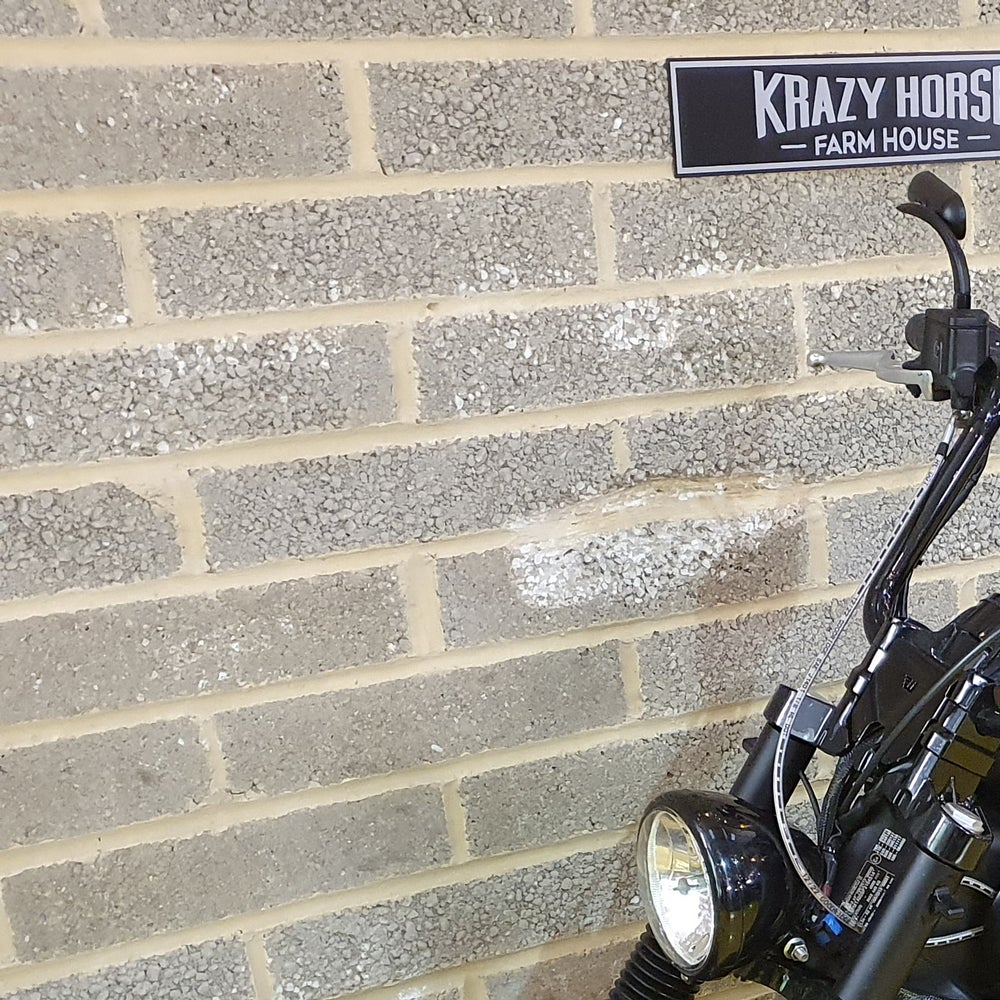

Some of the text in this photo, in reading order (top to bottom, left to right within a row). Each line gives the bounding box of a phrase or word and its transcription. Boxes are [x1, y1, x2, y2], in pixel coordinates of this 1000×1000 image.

[753, 69, 887, 139] KRAZY
[814, 126, 960, 156] FARM HOUSE
